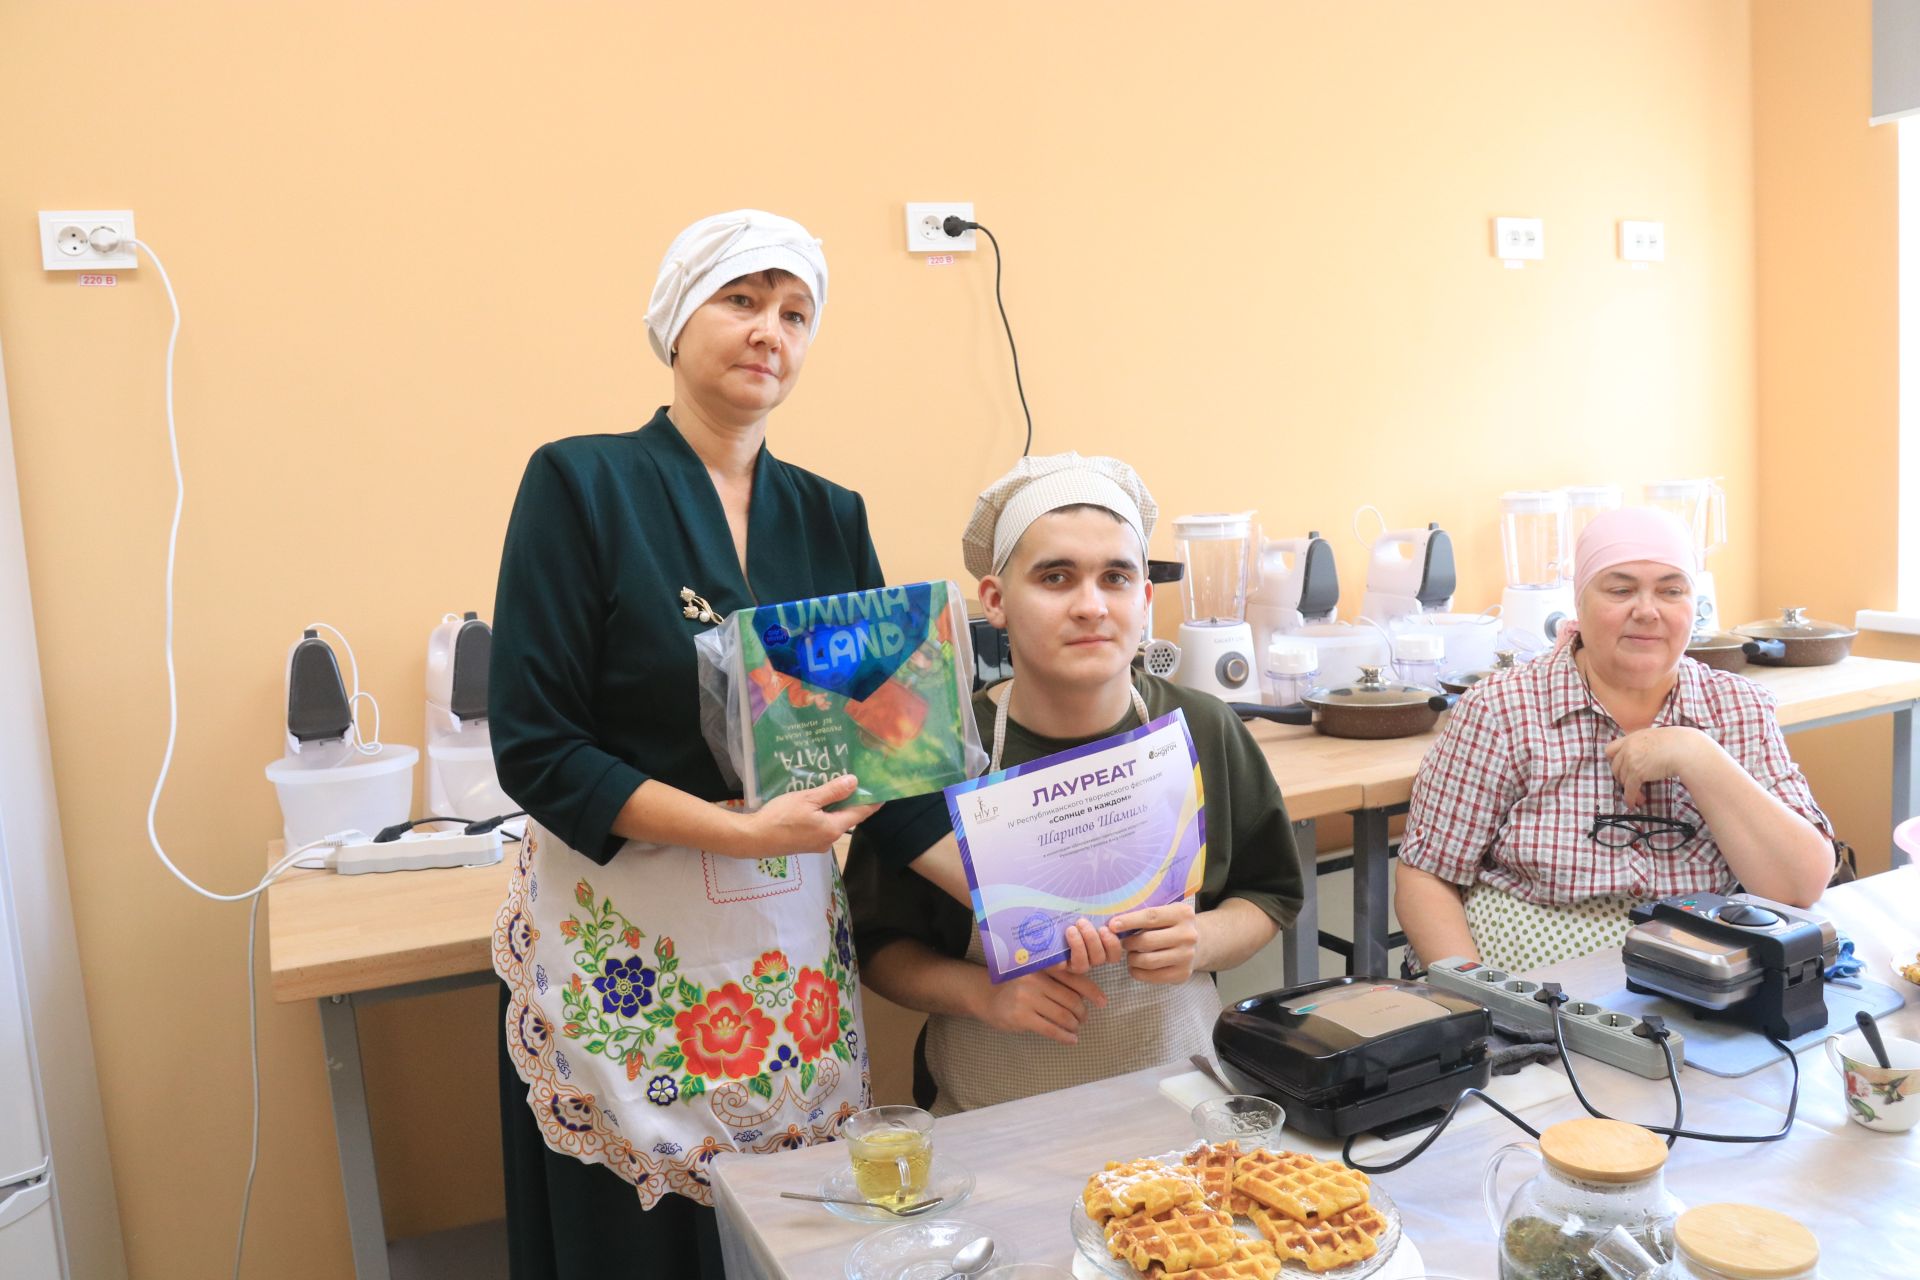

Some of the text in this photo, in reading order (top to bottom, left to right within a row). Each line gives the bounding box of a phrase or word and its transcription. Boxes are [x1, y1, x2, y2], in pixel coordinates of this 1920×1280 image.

[83, 276, 103, 285] 220
[775, 585, 911, 637] UMMA
[804, 621, 906, 673] LAND
[1032, 759, 1137, 807] ЛАУРЕАТ
[1016, 800, 1084, 826] Республиканского
[1085, 785, 1130, 803] творческого
[1037, 821, 1096, 847] Шарипов
[1097, 803, 1149, 828] Шамиль
[1048, 808, 1086, 825] «Солнце
[1094, 795, 1132, 811] каждом»
